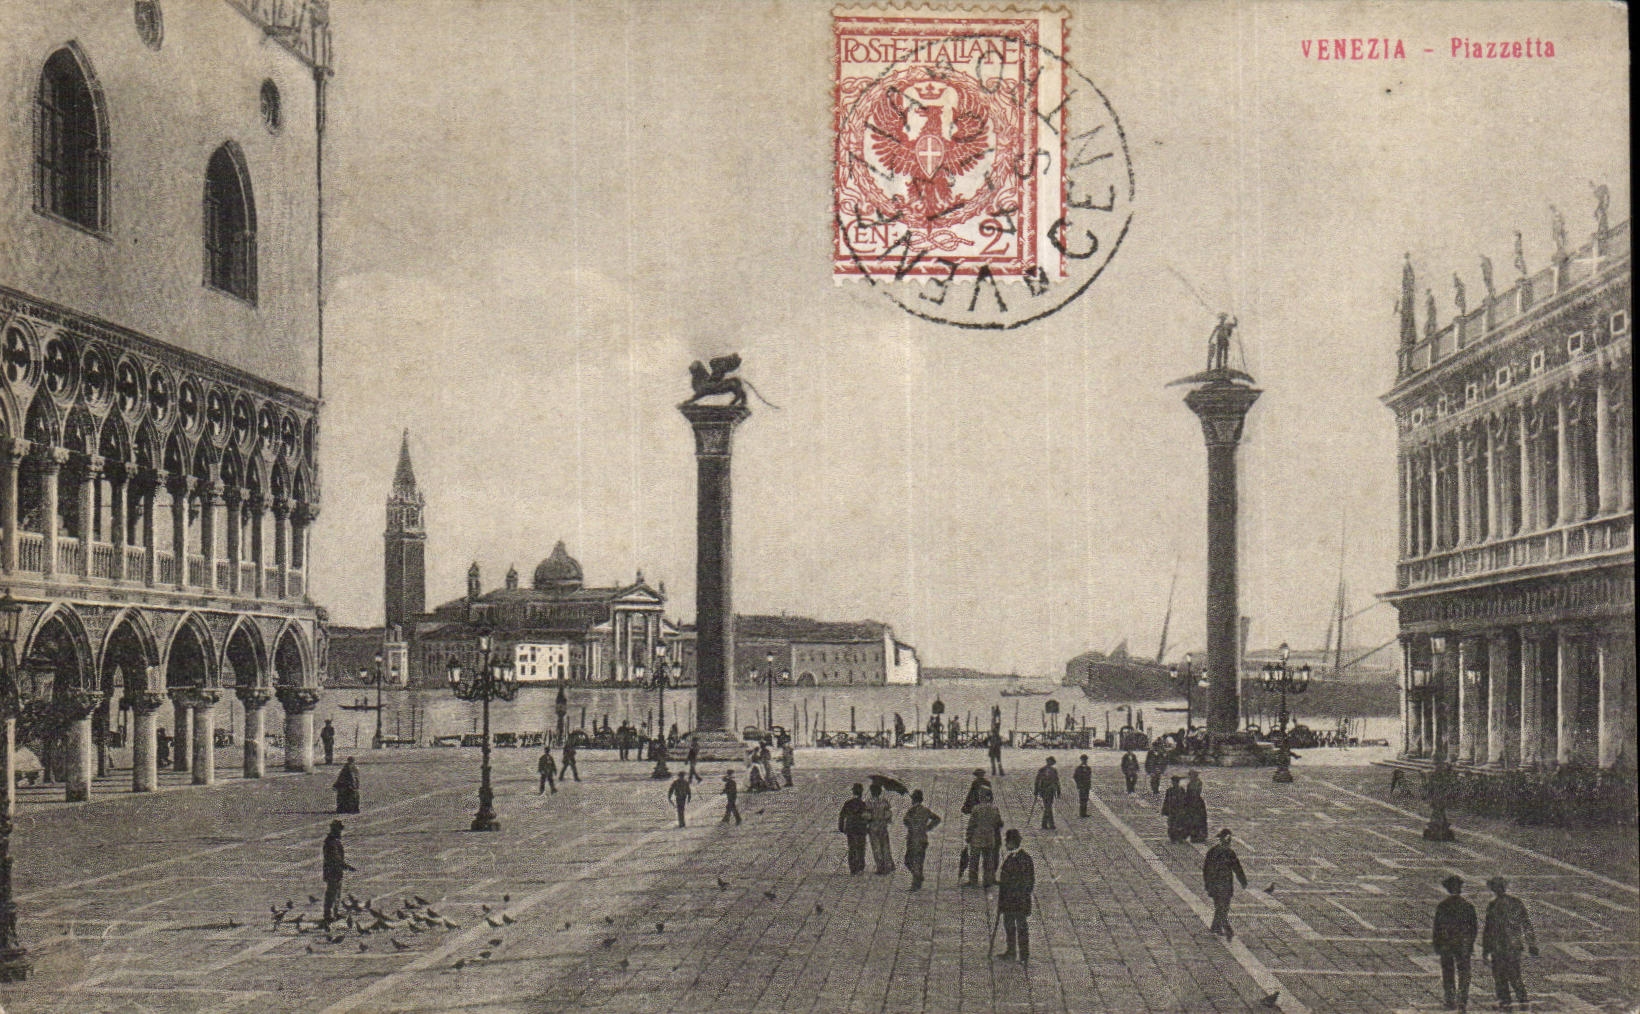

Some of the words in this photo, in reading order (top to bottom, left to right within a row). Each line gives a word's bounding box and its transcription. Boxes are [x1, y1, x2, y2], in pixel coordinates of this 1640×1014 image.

[841, 37, 908, 63] POSTE
[911, 37, 1018, 65] ITALIANE
[978, 218, 1010, 256] 2
